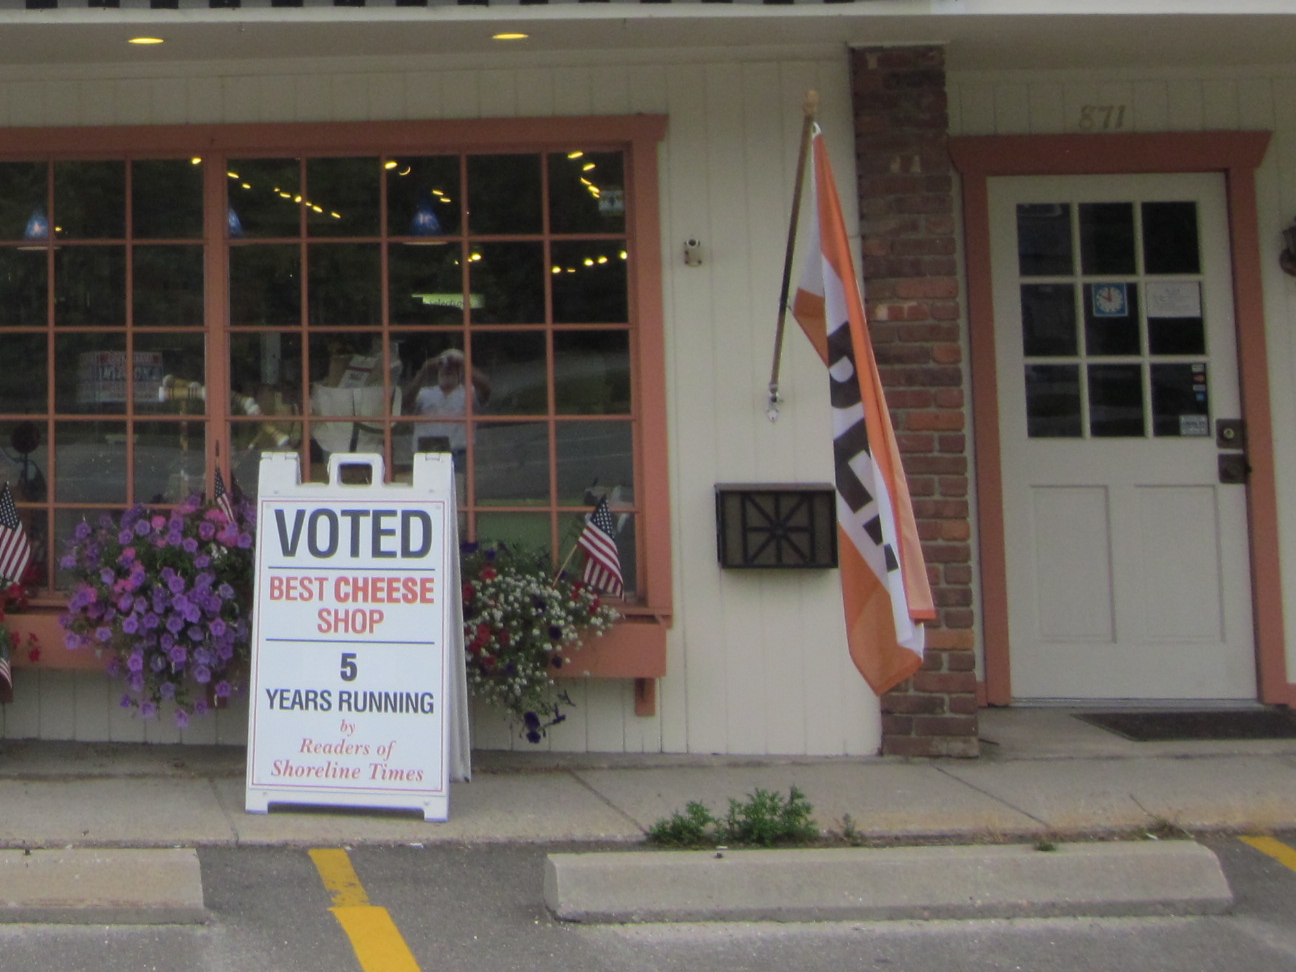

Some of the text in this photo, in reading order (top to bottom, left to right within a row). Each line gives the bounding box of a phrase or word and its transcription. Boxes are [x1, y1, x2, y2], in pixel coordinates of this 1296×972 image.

[1079, 105, 1125, 131] 871
[274, 508, 433, 559] VOTED
[269, 576, 435, 604] BEST CHEESE
[317, 608, 385, 634] SHOP
[340, 652, 358, 682] 5
[265, 688, 434, 714] YEARS RUNNING
[339, 719, 356, 735] by
[300, 737, 396, 761] Readers of
[270, 759, 424, 782] Shoreline Times
